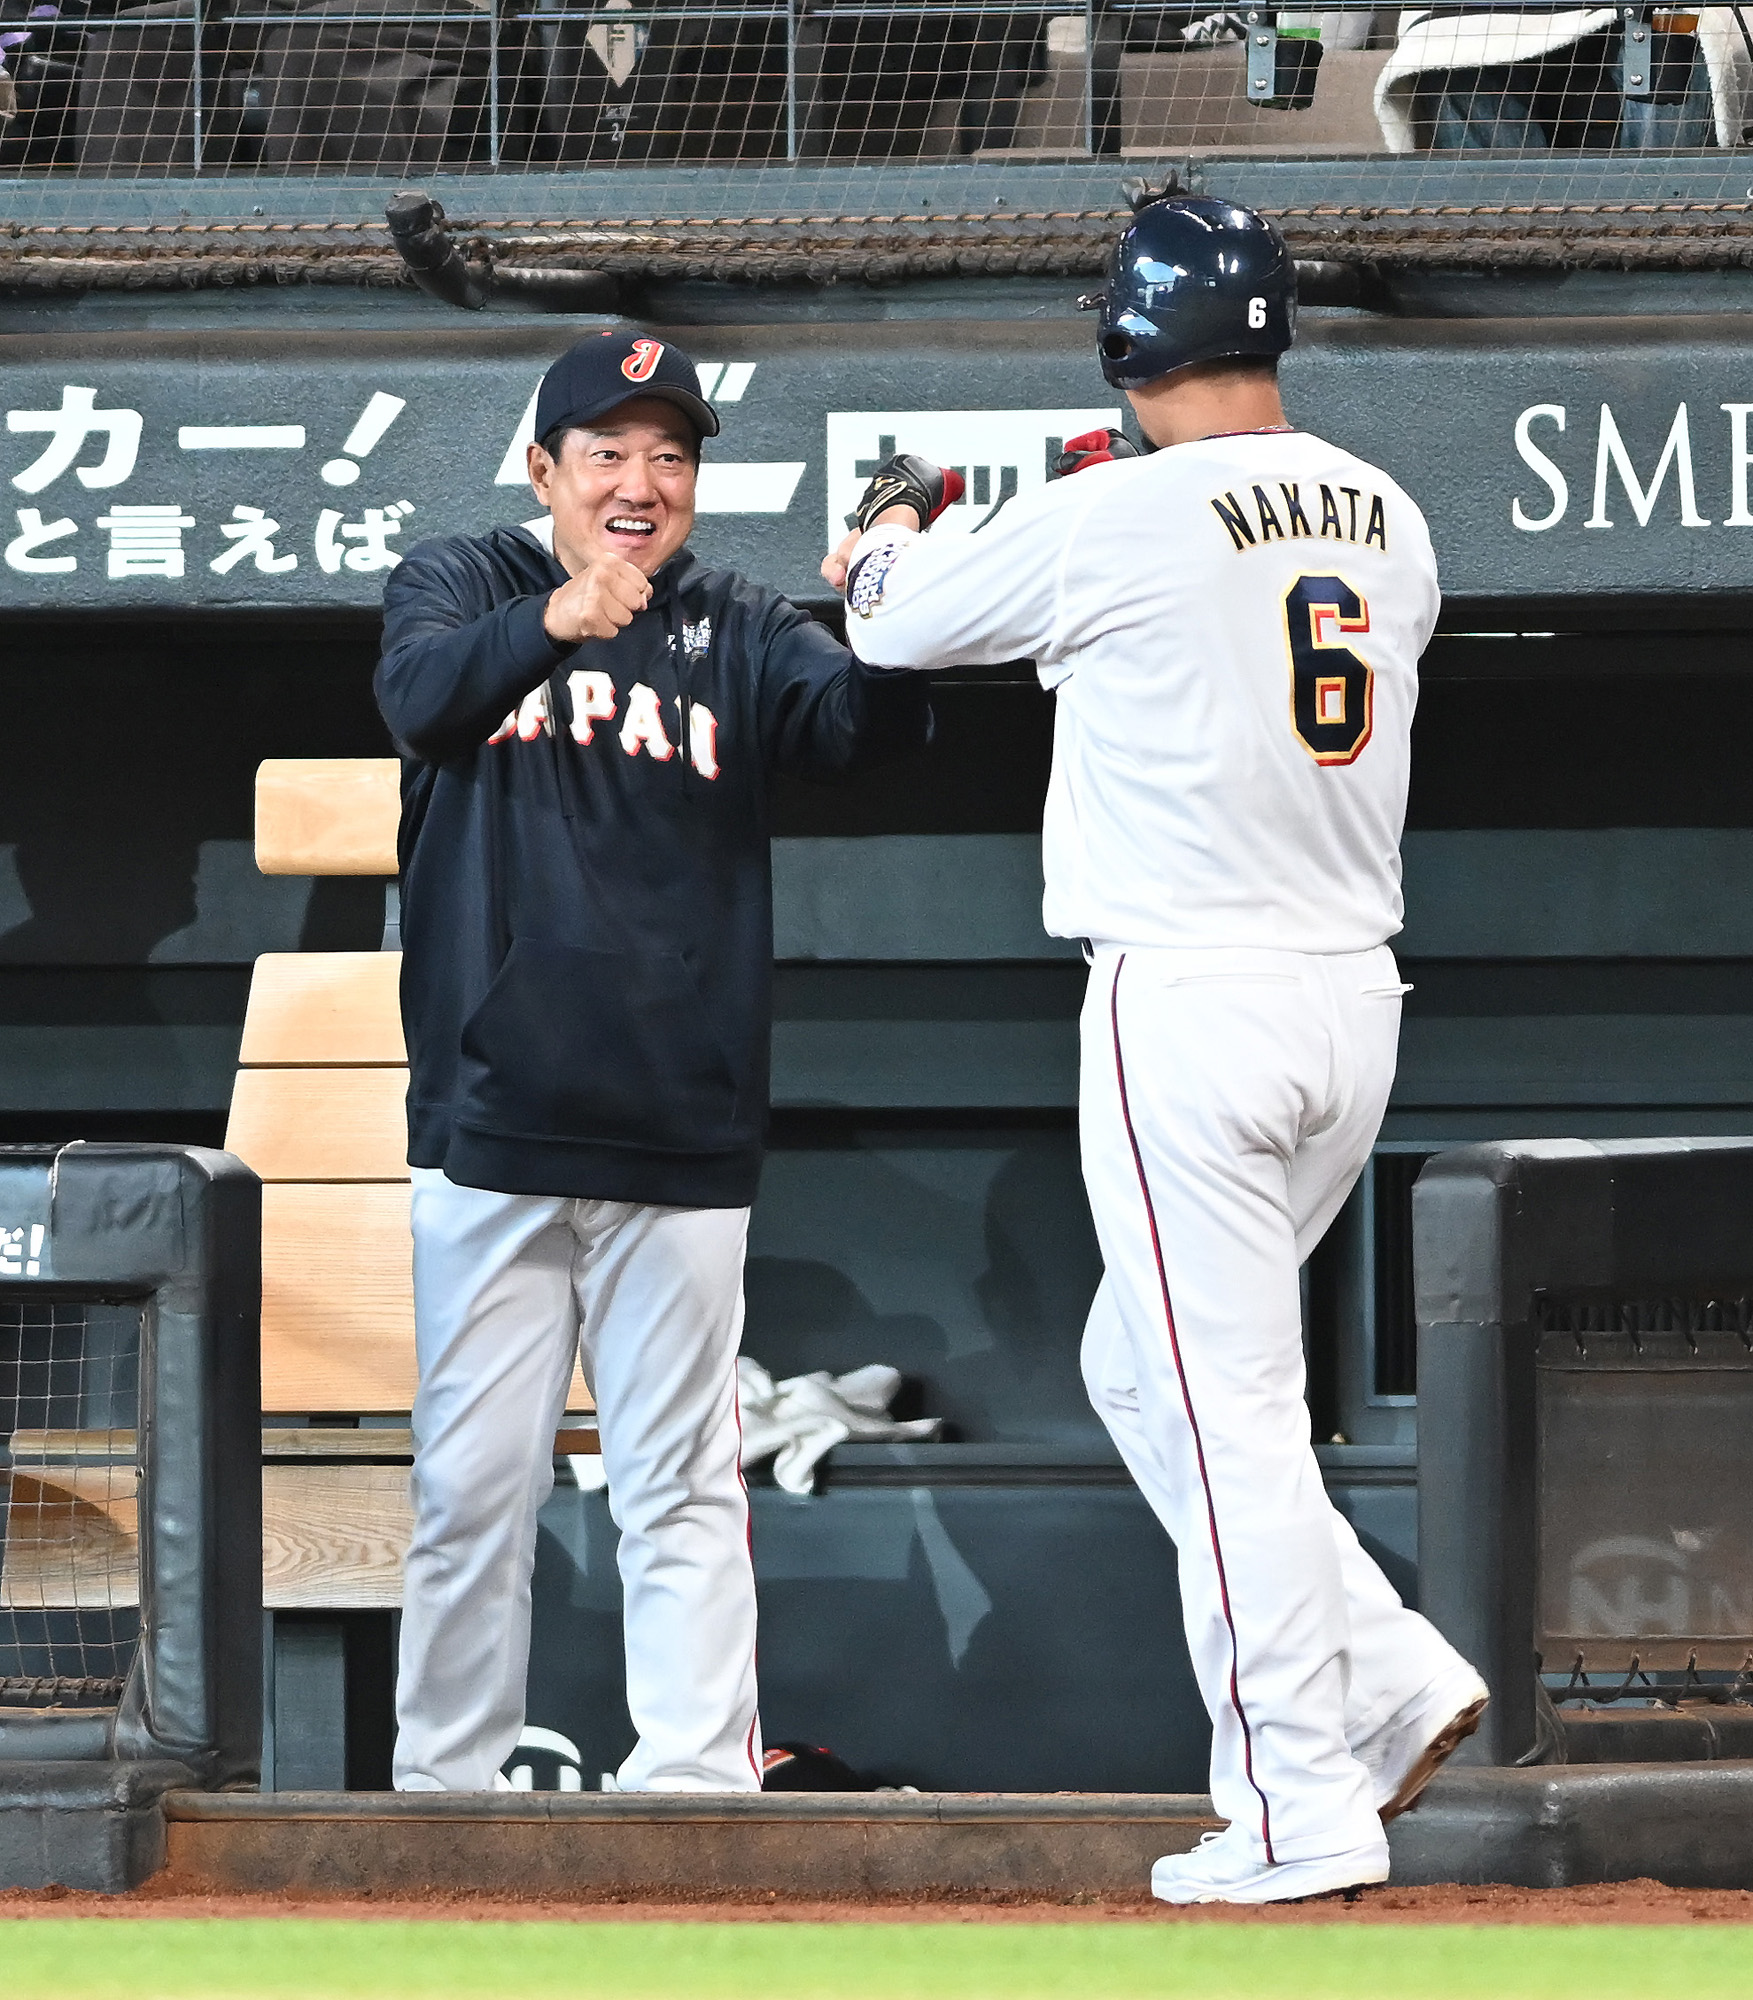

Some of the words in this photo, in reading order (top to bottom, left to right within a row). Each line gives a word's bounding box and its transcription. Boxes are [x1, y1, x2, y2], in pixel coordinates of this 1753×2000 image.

[1248, 297, 1267, 329] 6
[4, 500, 416, 580] と言えば
[1210, 482, 1388, 554] NAKATA
[1281, 570, 1374, 768] 6
